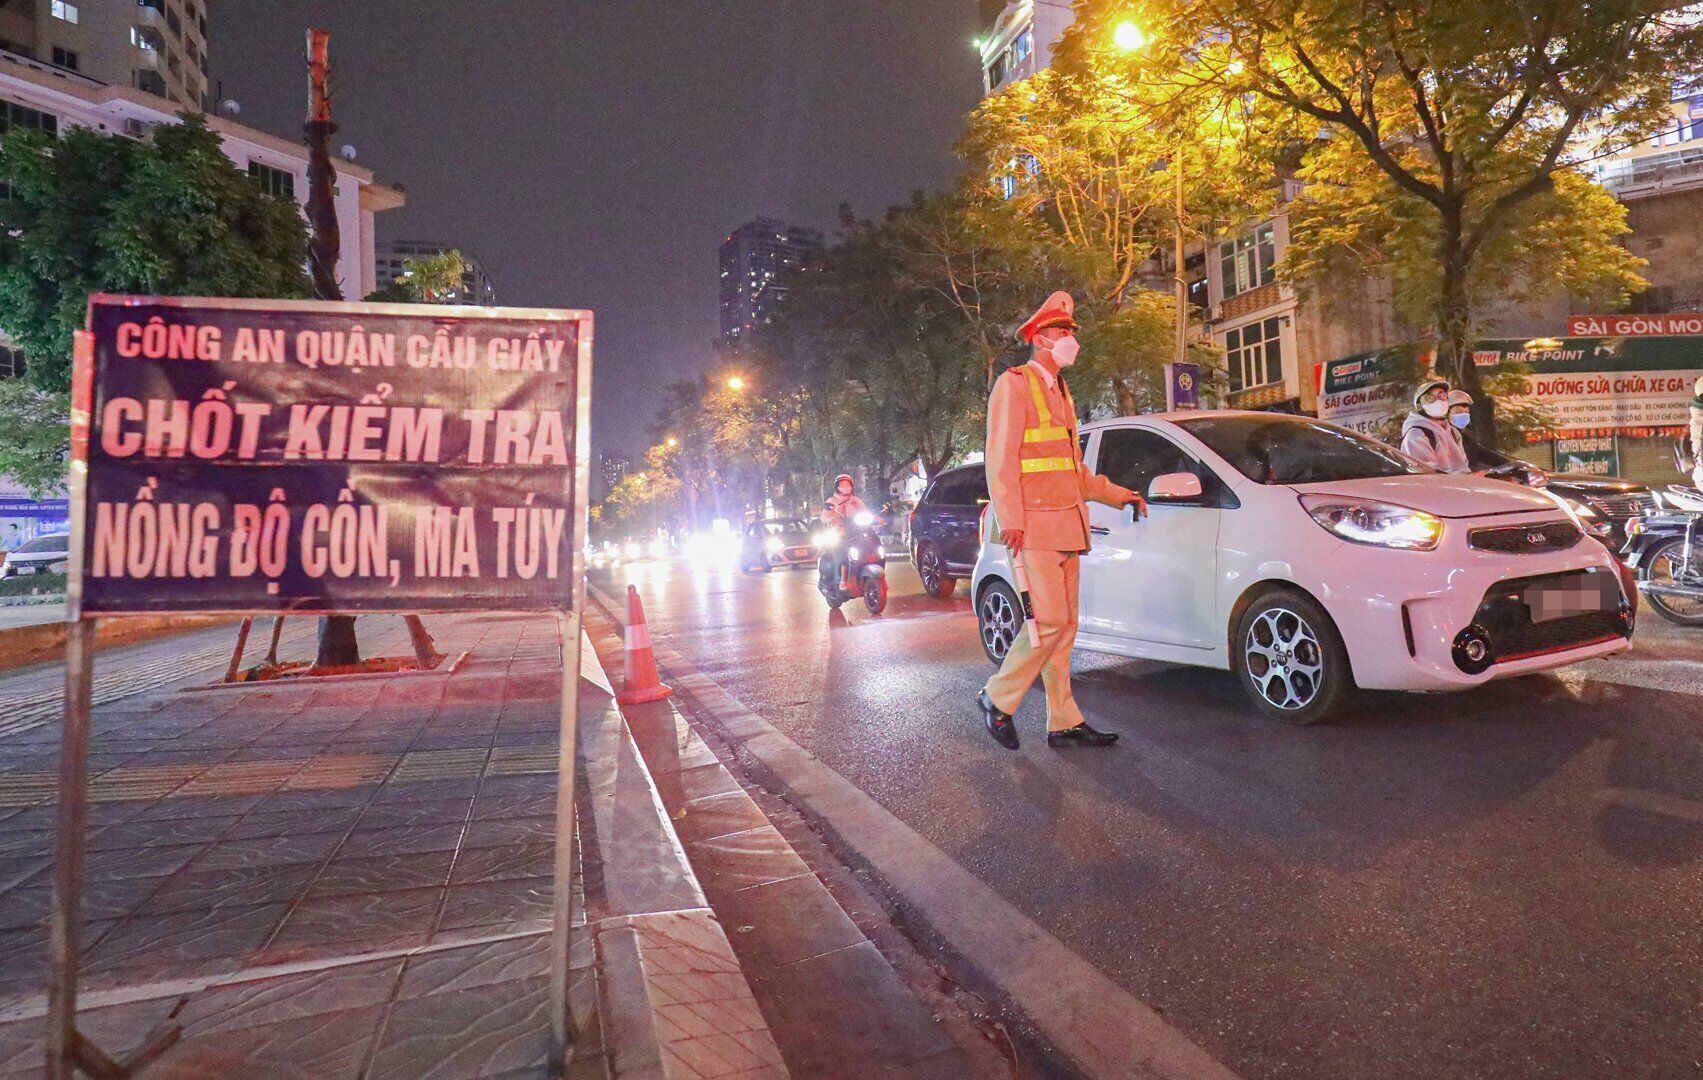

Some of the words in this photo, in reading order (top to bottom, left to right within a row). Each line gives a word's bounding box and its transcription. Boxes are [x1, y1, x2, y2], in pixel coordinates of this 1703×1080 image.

[1573, 318, 1608, 335] SÀI
[1615, 317, 1663, 334] GÒN
[1669, 319, 1703, 334] MO
[116, 316, 222, 361] CÔNG
[231, 327, 286, 363] AN
[295, 325, 396, 373] QUẬN
[406, 324, 477, 370] CẦU
[487, 328, 565, 372] GIẤY
[1506, 351, 1538, 361] BIKE
[1543, 350, 1586, 361] POINT
[1537, 376, 1584, 396] DƯỠNG
[1587, 373, 1610, 395] SỬA
[1614, 374, 1646, 394] CHỮA
[1650, 379, 1665, 393] XE
[1667, 378, 1684, 392] GA
[1343, 391, 1367, 406] GÒN
[101, 380, 272, 459] CHỐT
[284, 383, 444, 463] KIỂM
[463, 409, 568, 465] TRA
[92, 476, 221, 579] NỒNG
[229, 487, 291, 595] ĐỘ
[301, 478, 400, 587] CỒN,
[414, 505, 480, 578] MA
[492, 492, 566, 580] TÚY
